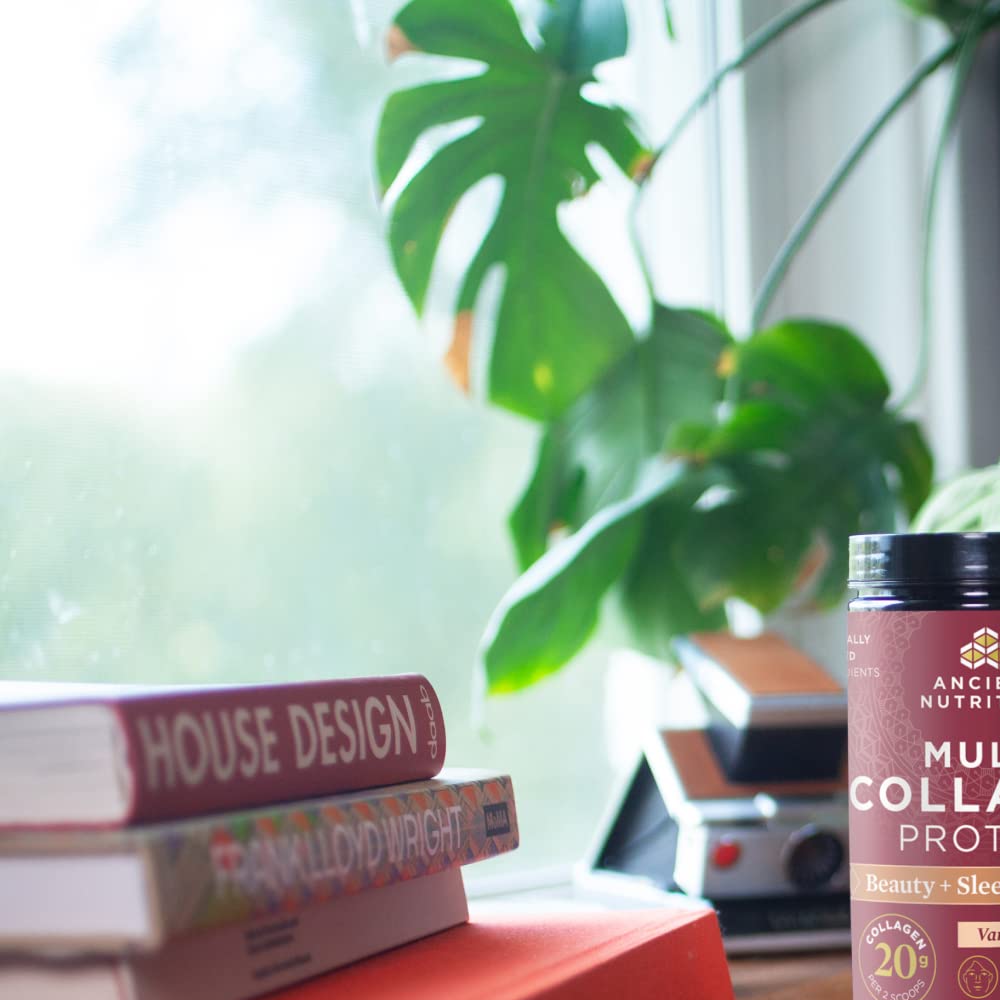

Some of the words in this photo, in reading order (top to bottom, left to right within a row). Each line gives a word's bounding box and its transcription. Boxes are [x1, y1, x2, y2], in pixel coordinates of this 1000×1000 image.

[848, 667, 880, 678] IENTS
[138, 706, 280, 788] HOUSE
[288, 694, 417, 769] DESIGN
[307, 819, 383, 880] LLOYD
[383, 805, 463, 862] WRIGHT
[866, 873, 935, 898] Beauty
[866, 920, 926, 950] COLLAGEN
[867, 974, 882, 994] PER
[882, 990, 889, 999] 2
